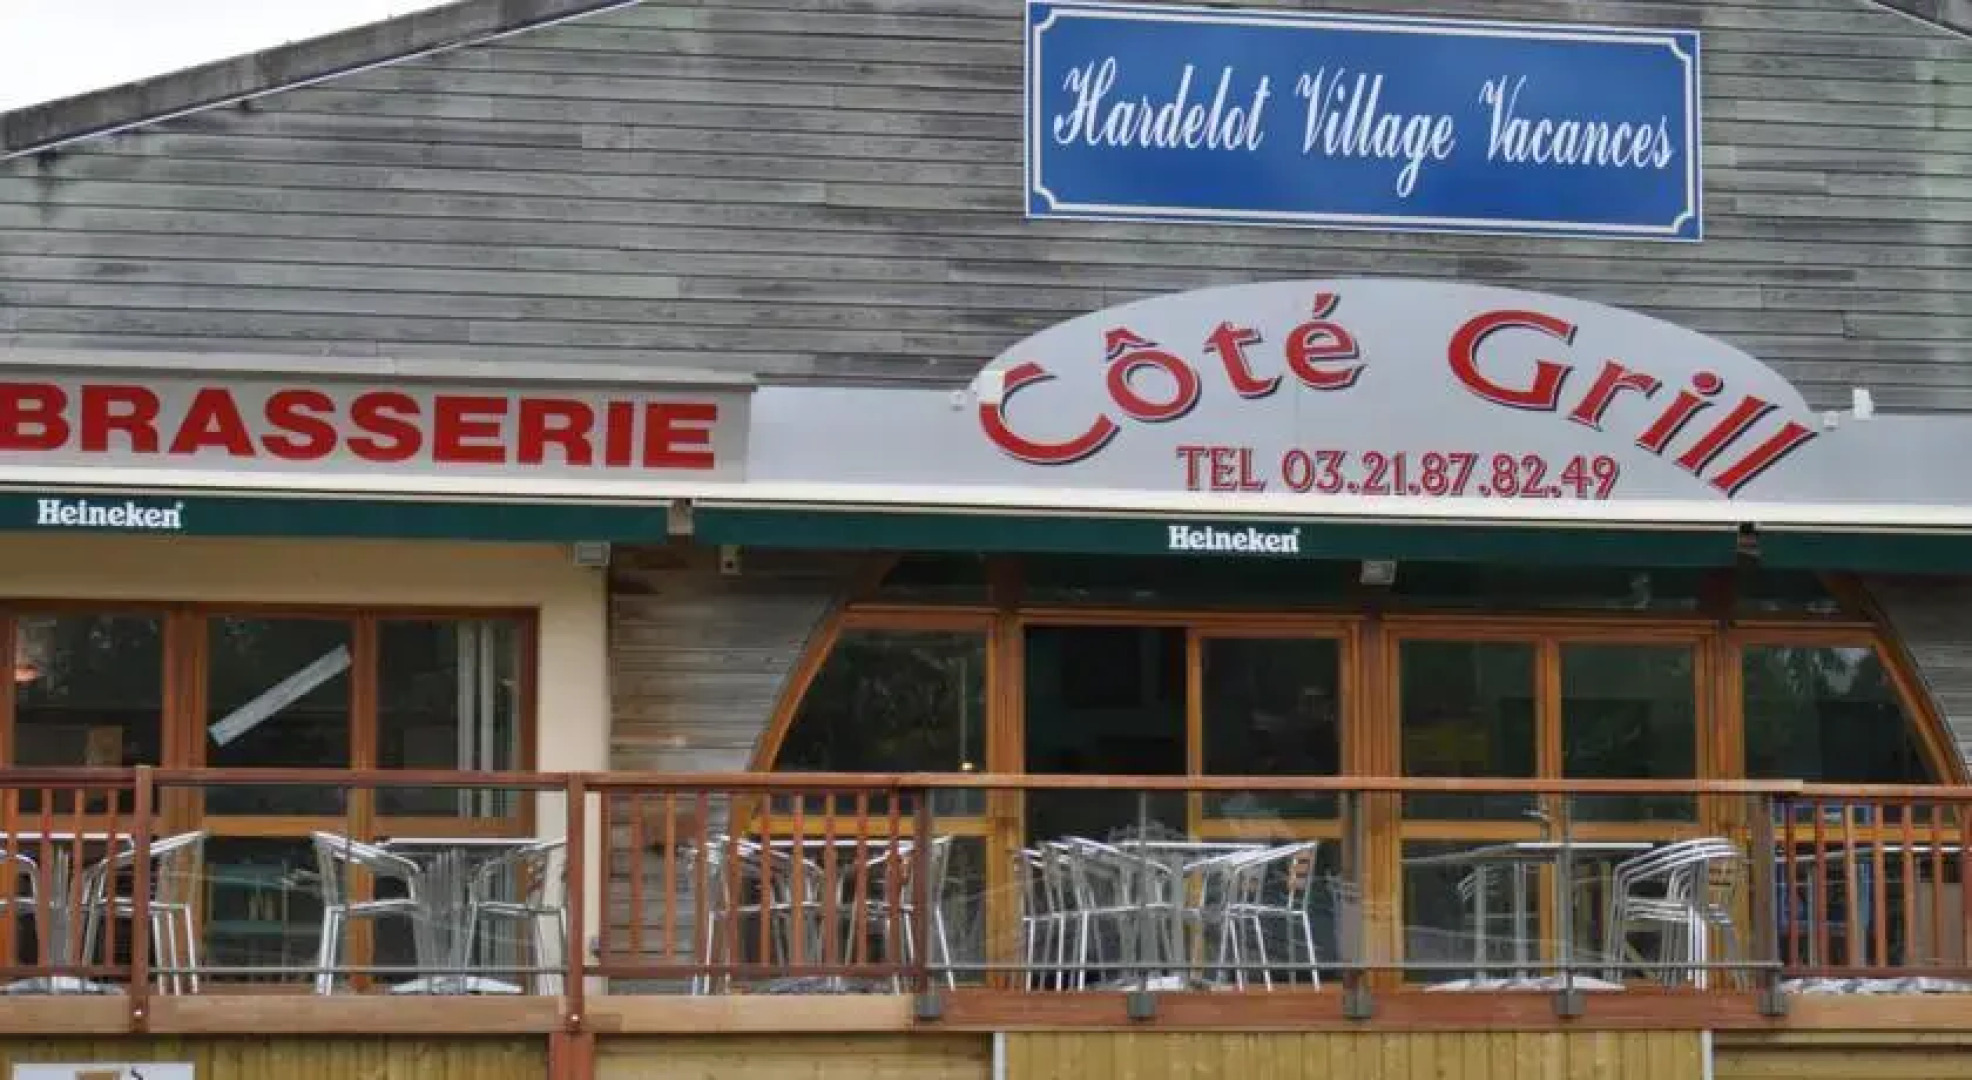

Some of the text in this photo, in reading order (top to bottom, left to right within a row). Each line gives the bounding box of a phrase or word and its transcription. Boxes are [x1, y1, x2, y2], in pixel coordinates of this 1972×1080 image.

[1053, 56, 1673, 198] Hardelot Village Vacances
[0, 382, 718, 470] BRASSERIE
[977, 293, 1818, 499] Côté Grill
[1175, 445, 1620, 501] TEL 03.21.87.82.49
[37, 499, 183, 530] Heineken
[1168, 524, 1300, 554] Heineken
